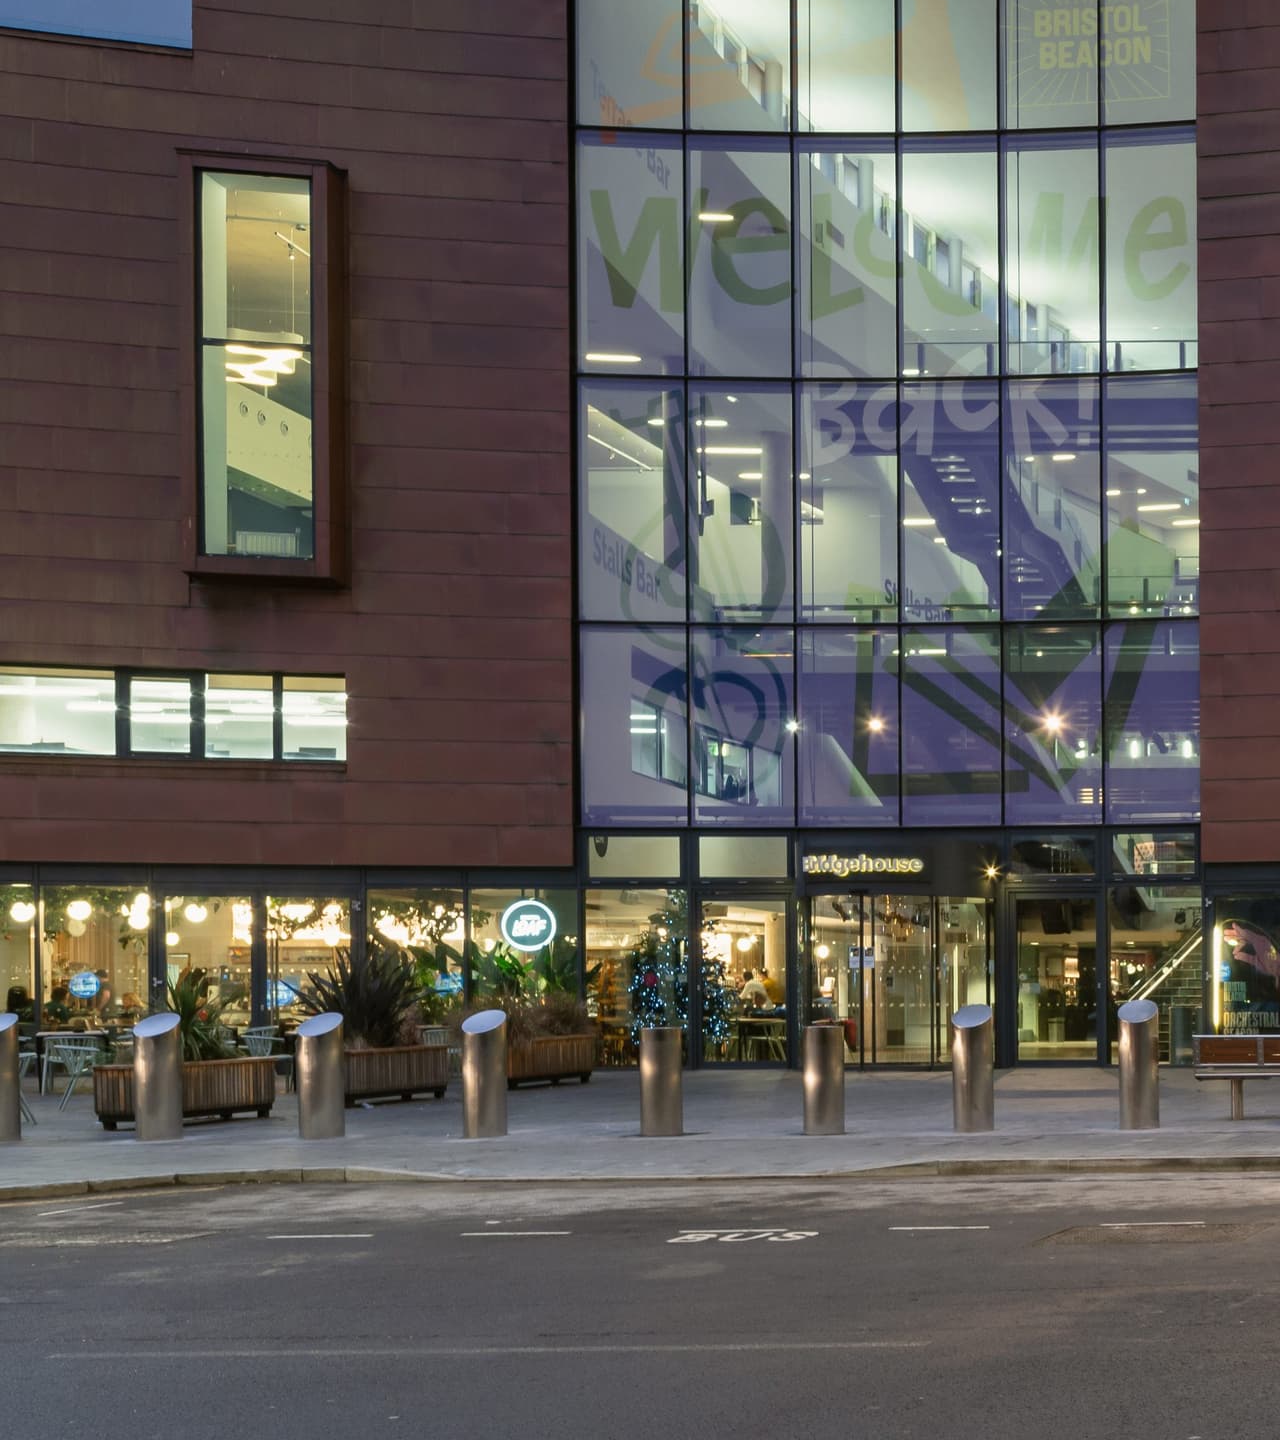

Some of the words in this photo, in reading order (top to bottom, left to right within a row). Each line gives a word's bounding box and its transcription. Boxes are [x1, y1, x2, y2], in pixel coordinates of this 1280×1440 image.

[1034, 4, 1148, 38] BRISTOL
[1039, 35, 1152, 70] BEACON
[646, 146, 671, 191] Bar
[593, 527, 632, 586] Stalls
[635, 556, 661, 602] Bar
[1223, 1011, 1280, 1028] ORCHESTRAL
[666, 1231, 820, 1243] BUS
